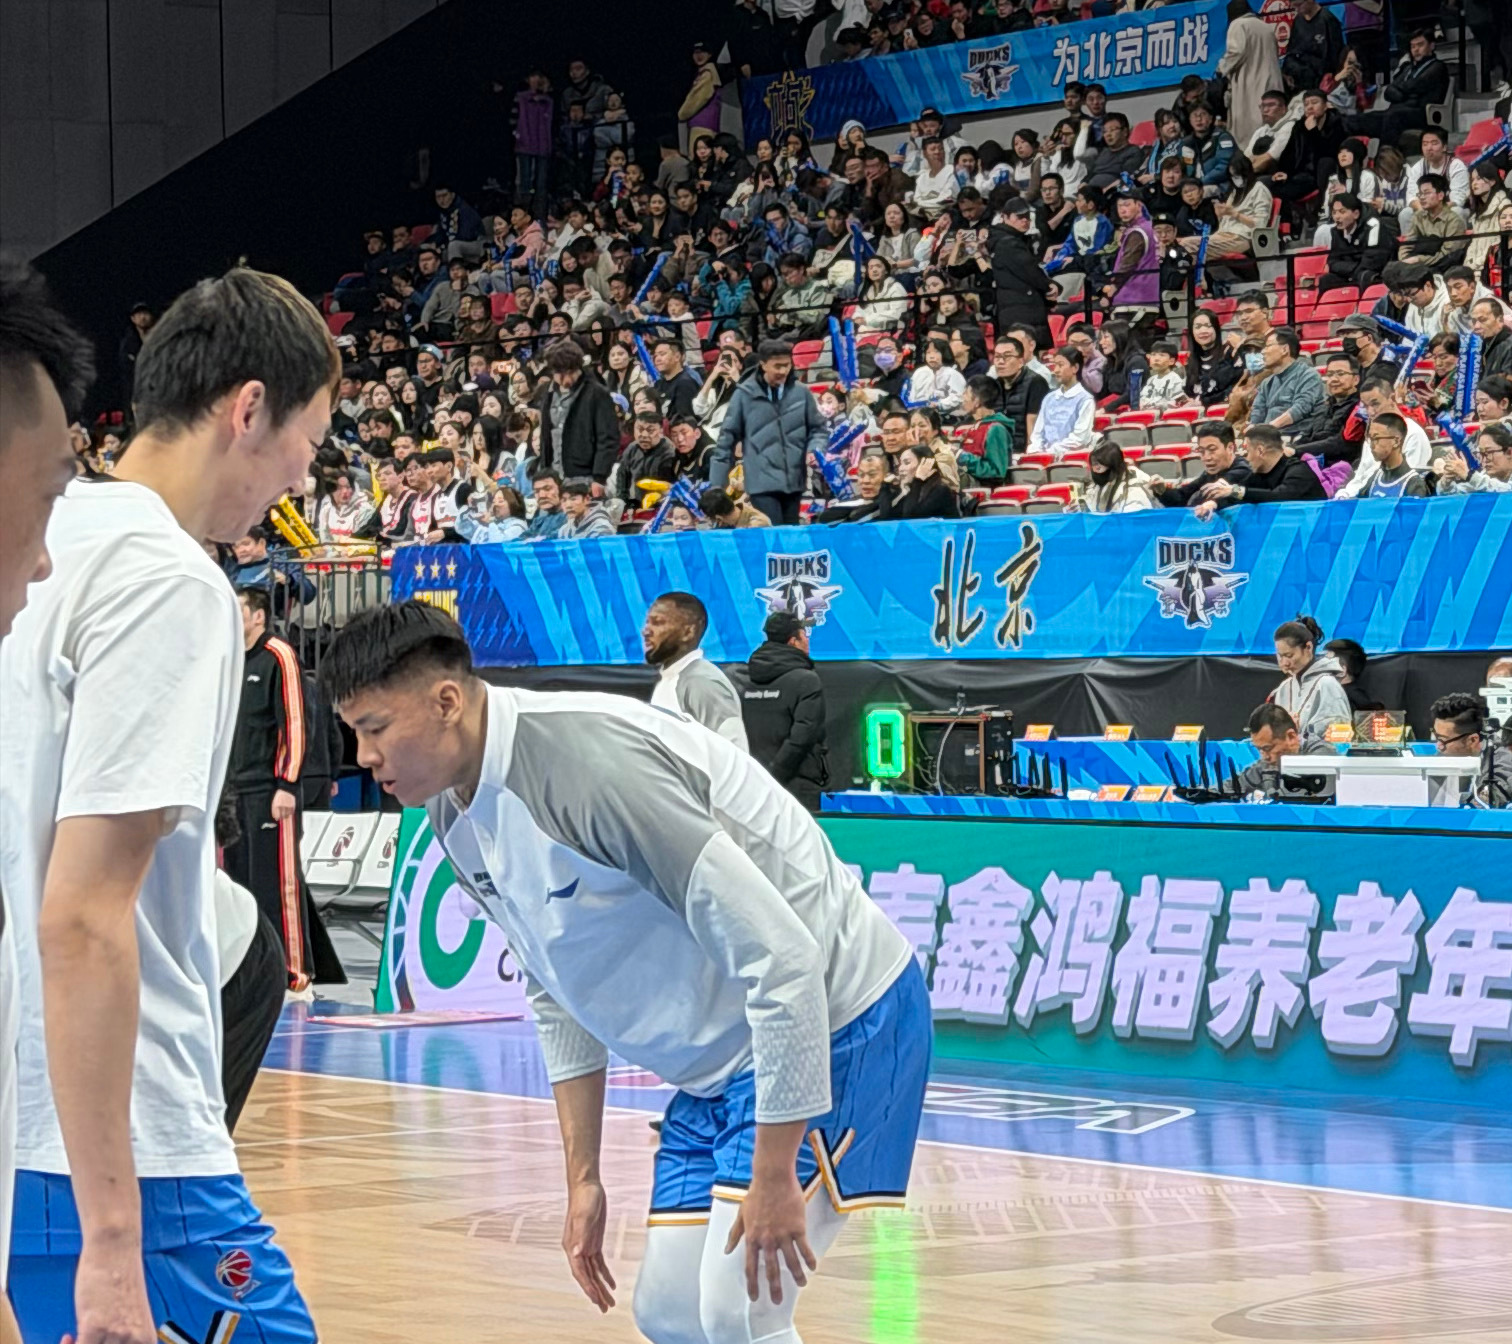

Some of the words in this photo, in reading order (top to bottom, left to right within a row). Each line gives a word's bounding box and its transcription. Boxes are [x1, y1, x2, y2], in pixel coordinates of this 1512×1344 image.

[1052, 13, 1210, 87] 为北京而战
[767, 553, 828, 582] DUCKS
[931, 521, 1043, 652] 北京
[1158, 536, 1233, 570] DUCKS
[865, 709, 906, 779] 0
